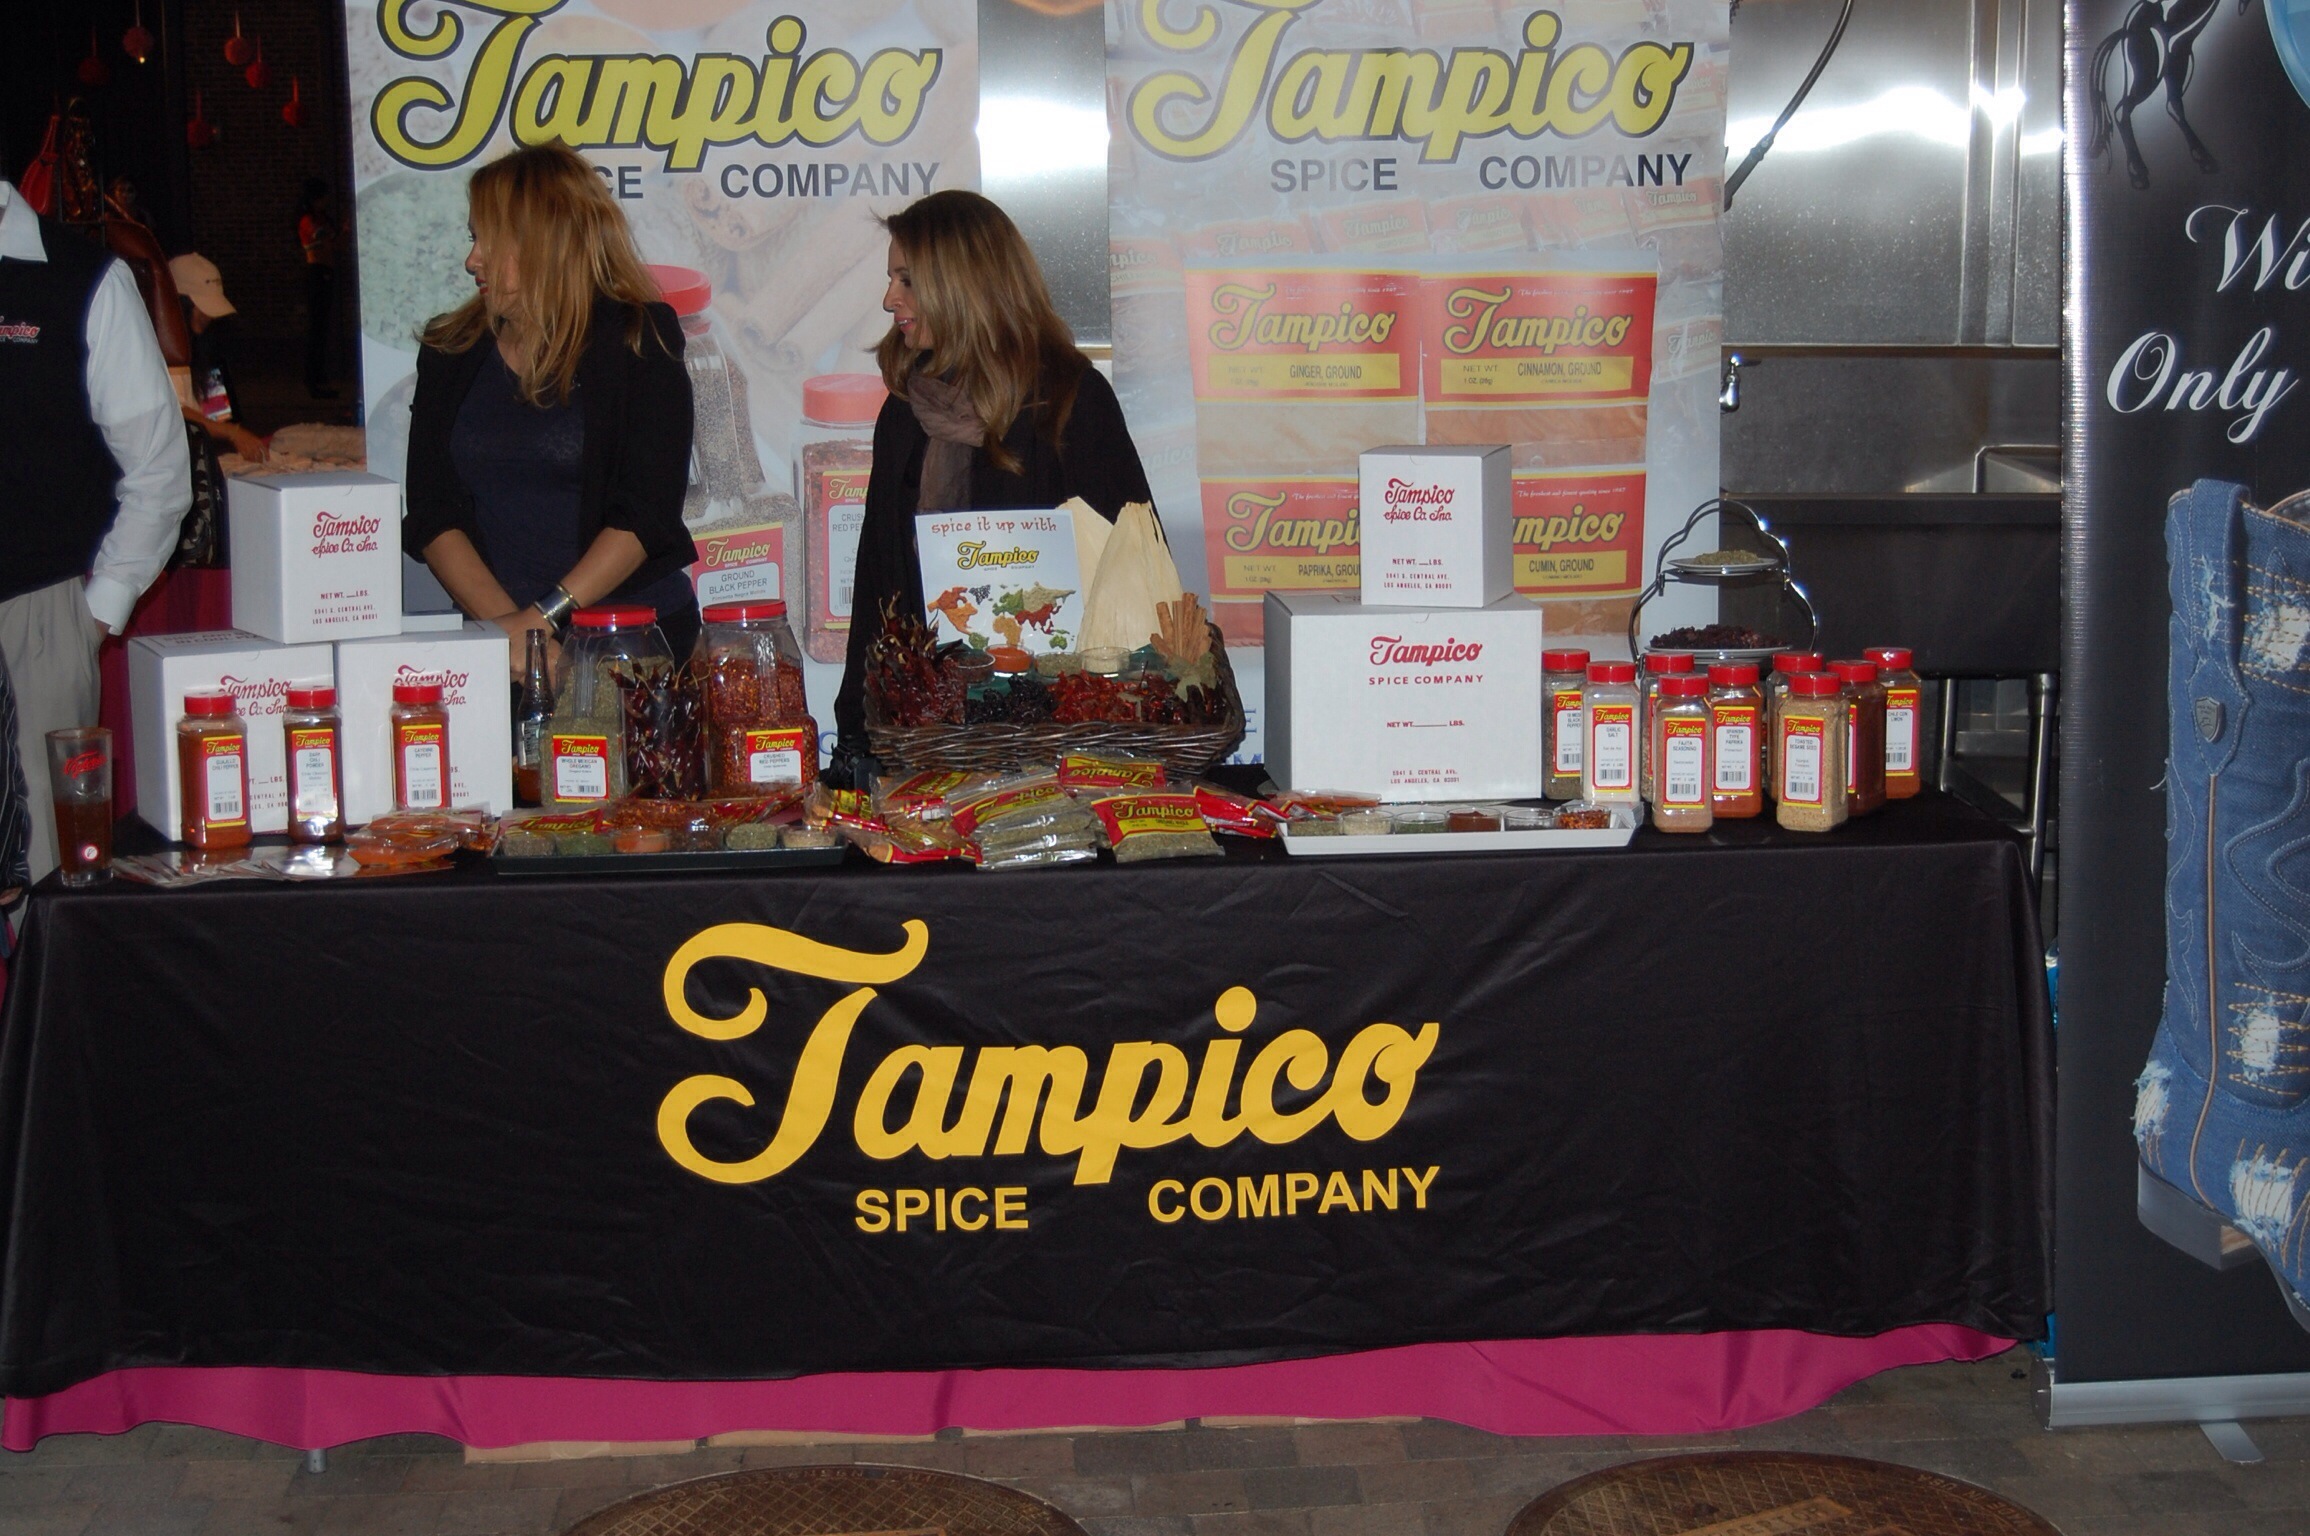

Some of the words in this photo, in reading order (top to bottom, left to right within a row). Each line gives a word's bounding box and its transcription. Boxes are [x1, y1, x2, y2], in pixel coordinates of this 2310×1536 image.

[371, 0, 942, 173] Tampico
[1126, 0, 1694, 163] Tampico
[720, 162, 940, 199] COMPANY
[1270, 157, 1398, 193] SPICE
[1479, 153, 1693, 190] COMPANY
[1208, 282, 1396, 352] Tampico
[1443, 286, 1634, 355] Tampico
[1289, 364, 1323, 380] GINGER,
[1325, 365, 1362, 379] GROUND
[1463, 364, 1481, 373] NET
[1517, 362, 1566, 377] CINNAMON,
[1567, 361, 1602, 376] GROUND
[2106, 326, 2300, 444] Only
[1384, 477, 1455, 505] Tampico
[313, 511, 381, 539] Tampico
[832, 524, 849, 532] RED
[931, 518, 971, 537] spice
[977, 516, 990, 531] it
[996, 520, 1015, 533] up
[1020, 517, 1057, 532] with
[1225, 491, 1361, 555] Tampi
[706, 538, 771, 567] Tampico
[957, 541, 1039, 570] Tampico
[1298, 564, 1334, 578] PAPRIKA,
[1335, 564, 1361, 576] GROU
[1528, 560, 1558, 574] CUMIN,
[1560, 558, 1595, 572] GROUND
[721, 569, 755, 582] GROUND
[709, 583, 736, 595] BLACK
[737, 578, 768, 590] PEPPER
[320, 592, 333, 600] NET
[1369, 634, 1483, 667] Tampico
[1368, 676, 1409, 686] SPICE
[1414, 675, 1484, 685] COMPANY
[1595, 709, 1629, 722] Tampico
[1716, 711, 1752, 724] Tampico
[1667, 721, 1703, 735] Tampico
[1787, 719, 1821, 733] Tampico
[296, 733, 331, 747] Tampico
[404, 729, 440, 743] Tampico
[756, 735, 796, 751] Tampico
[206, 741, 241, 755] Tampico
[561, 739, 600, 755] Tampico
[1111, 800, 1195, 819] Tampico
[657, 919, 1440, 1187] Tampico
[854, 1186, 1029, 1234] SPICE
[1147, 1165, 1441, 1226] COMPANY
